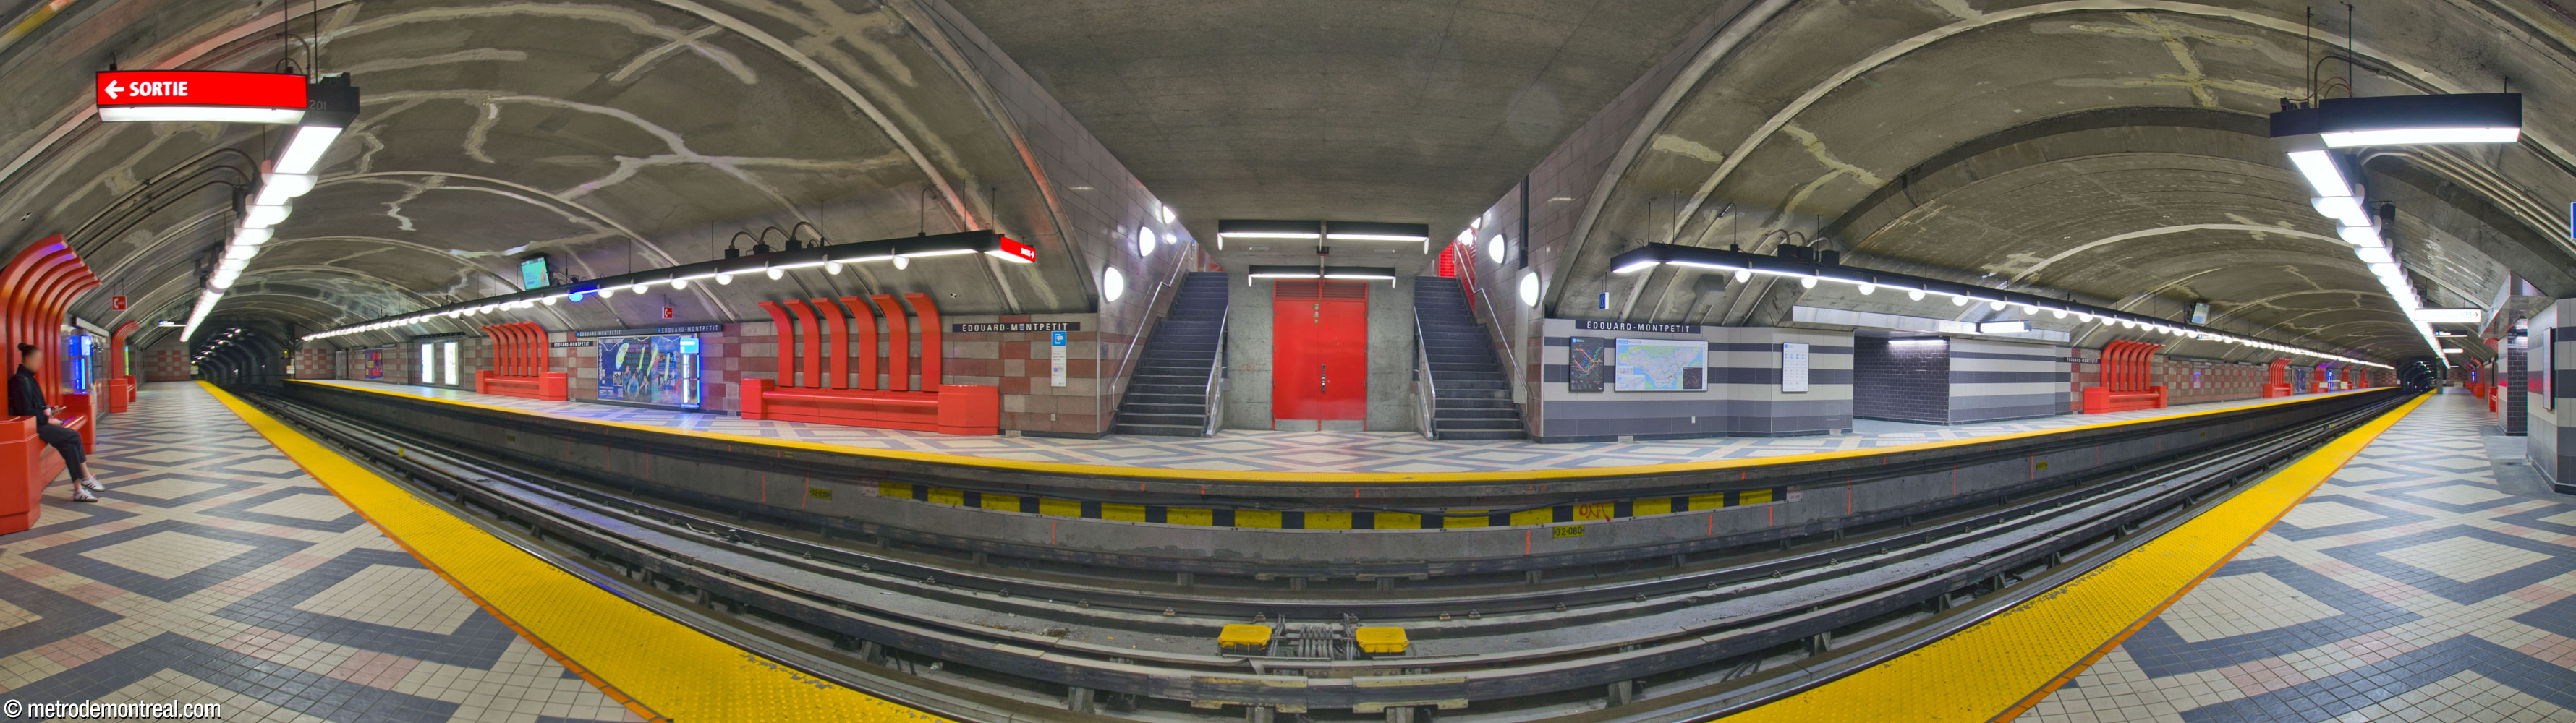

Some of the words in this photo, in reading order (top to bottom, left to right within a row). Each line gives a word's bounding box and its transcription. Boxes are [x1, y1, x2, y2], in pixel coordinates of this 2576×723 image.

[129, 81, 188, 96] SORTIE
[962, 323, 1068, 332] ÉDOUARD-MNTPETIT
[1586, 321, 1690, 333] ÉDOUARD-MONTPETIT
